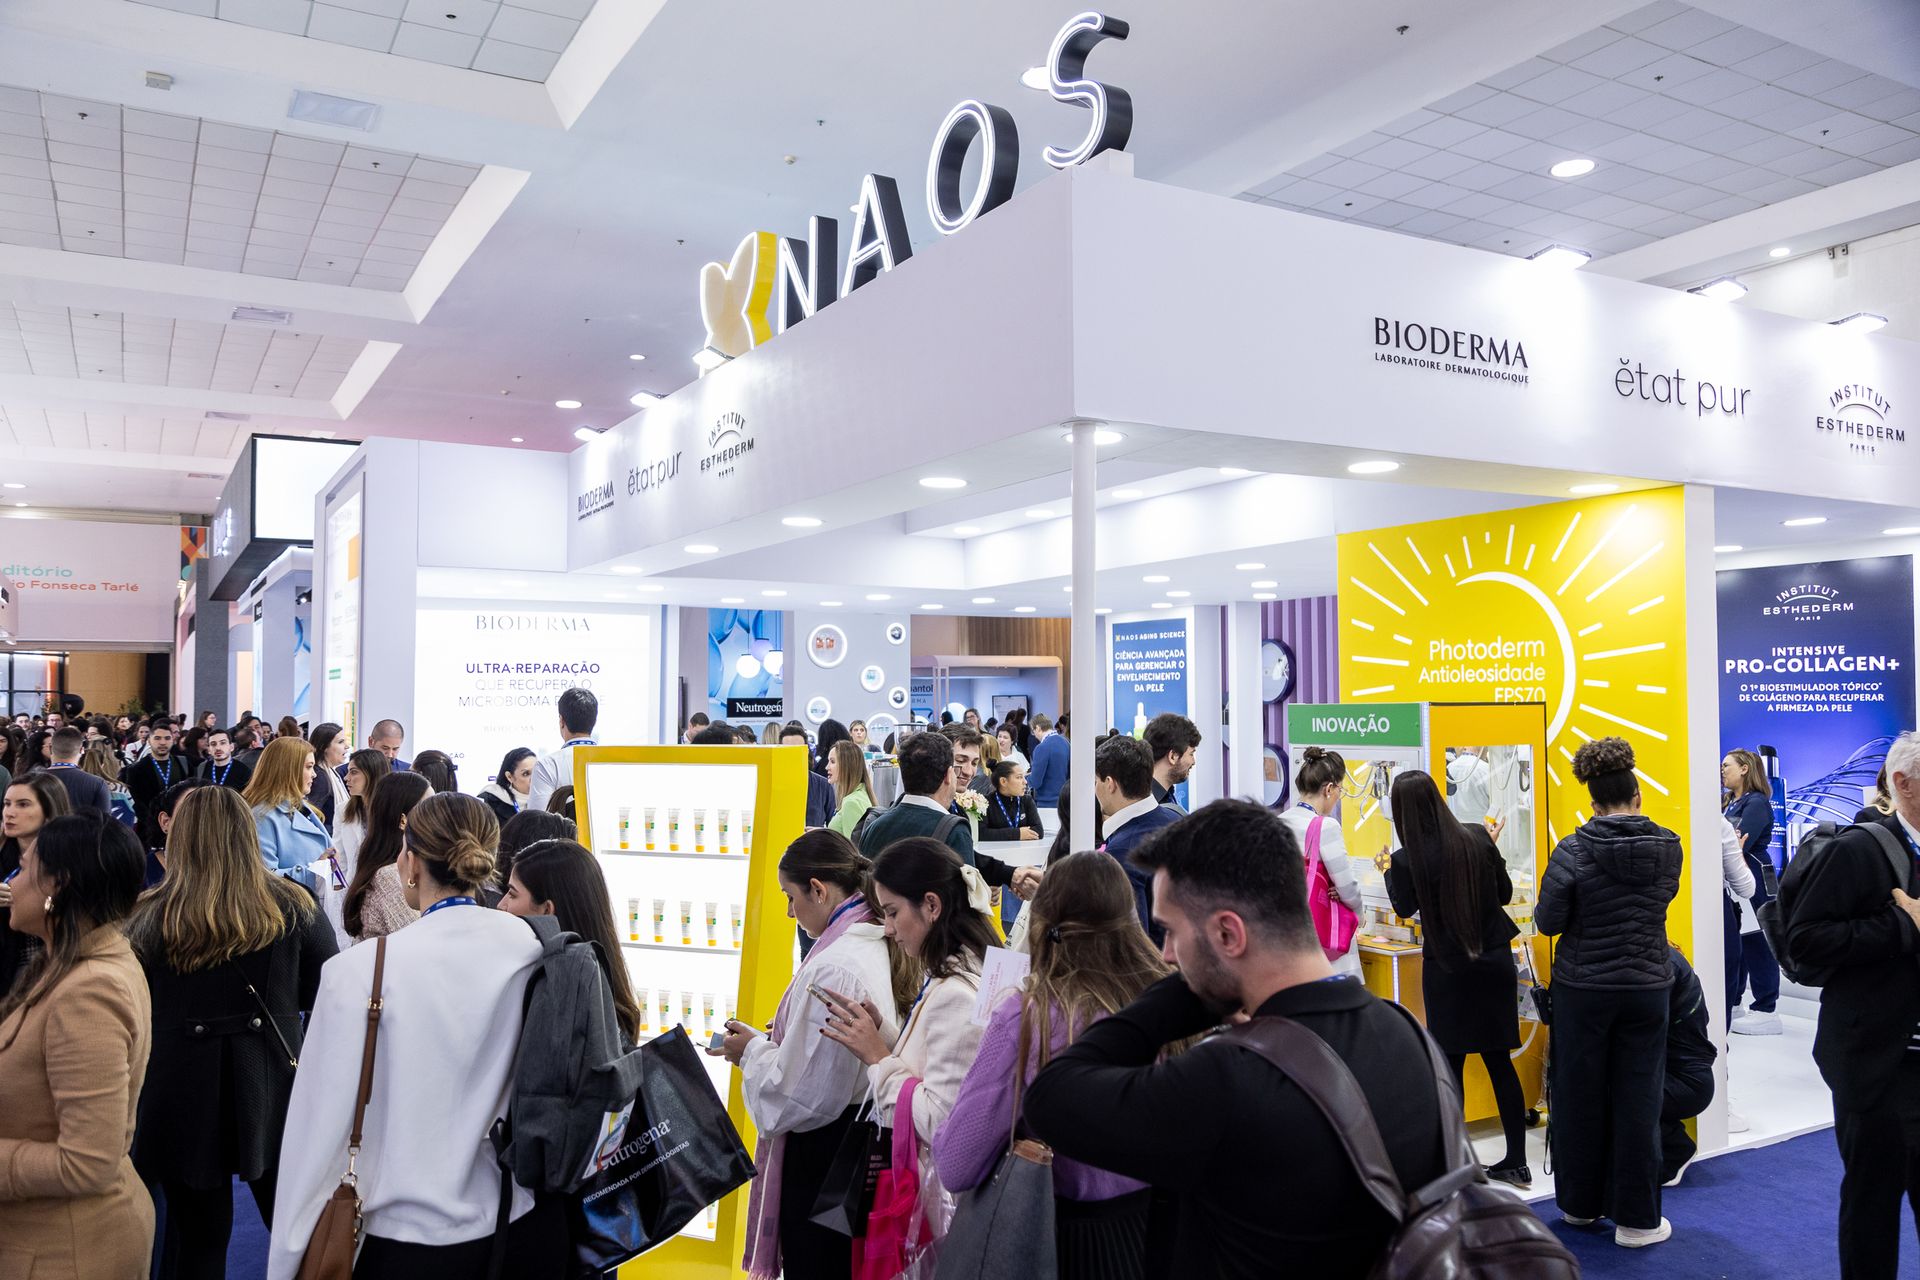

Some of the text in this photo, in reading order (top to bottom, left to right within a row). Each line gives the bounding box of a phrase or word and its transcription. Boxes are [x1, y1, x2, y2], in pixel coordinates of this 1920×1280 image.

[778, 10, 1133, 335] NAOS
[1374, 316, 1529, 369] BIODERMA
[1374, 352, 1529, 384] LABORATOIRE DERMATOLOGIQUE
[1698, 380, 1751, 418] pur
[1829, 384, 1892, 414] INSTITUT
[708, 411, 746, 447] INSTITUT
[1816, 416, 1906, 443] ESTHEDERM
[700, 437, 755, 472] ESTHEDERM
[1850, 443, 1876, 453] PARIS
[657, 451, 683, 489] pur
[578, 480, 615, 512] BIODERMA
[2, 564, 73, 578] ditório
[30, 580, 97, 591] Fonseca
[101, 582, 140, 592] Tarlé
[1775, 584, 1839, 603] INSTITUT
[1763, 602, 1855, 615] ESTHEDERM
[476, 615, 591, 632] BIODERMA
[1140, 632, 1158, 640] AGING
[1160, 630, 1185, 639] SCIENCE
[1115, 649, 1185, 660] CIÊNCIA AVANÇADA
[1429, 635, 1546, 662] Photoderm
[1772, 645, 1846, 657] INTENSIVE
[466, 661, 601, 676] ULTRA-REPARAÇÃO
[1115, 660, 1185, 671] PARA GERENCIAR O
[1418, 658, 1546, 684] Antioleosidade
[1725, 655, 1901, 674] PRO-COLLAGEN+
[475, 679, 592, 691] QUE RECUPERA O
[1117, 672, 1181, 682] ENVELHECIMENTO
[1134, 684, 1165, 692] DA PELE
[1494, 687, 1546, 703] FPS70
[1740, 684, 1748, 692] O
[1759, 683, 1840, 692] BIOESTIMULADOR
[458, 696, 550, 708] MICROBIOMA
[1739, 692, 1884, 702] DE COLÁGENO PARA RECUPERAR
[735, 701, 783, 715] Neutrogen
[1767, 704, 1852, 712] A FIRMEZA DA PELE
[1311, 714, 1391, 737] INOVAÇÃO
[583, 1140, 690, 1204] RECOMENDADA POR DERMATOLOGISTAS
